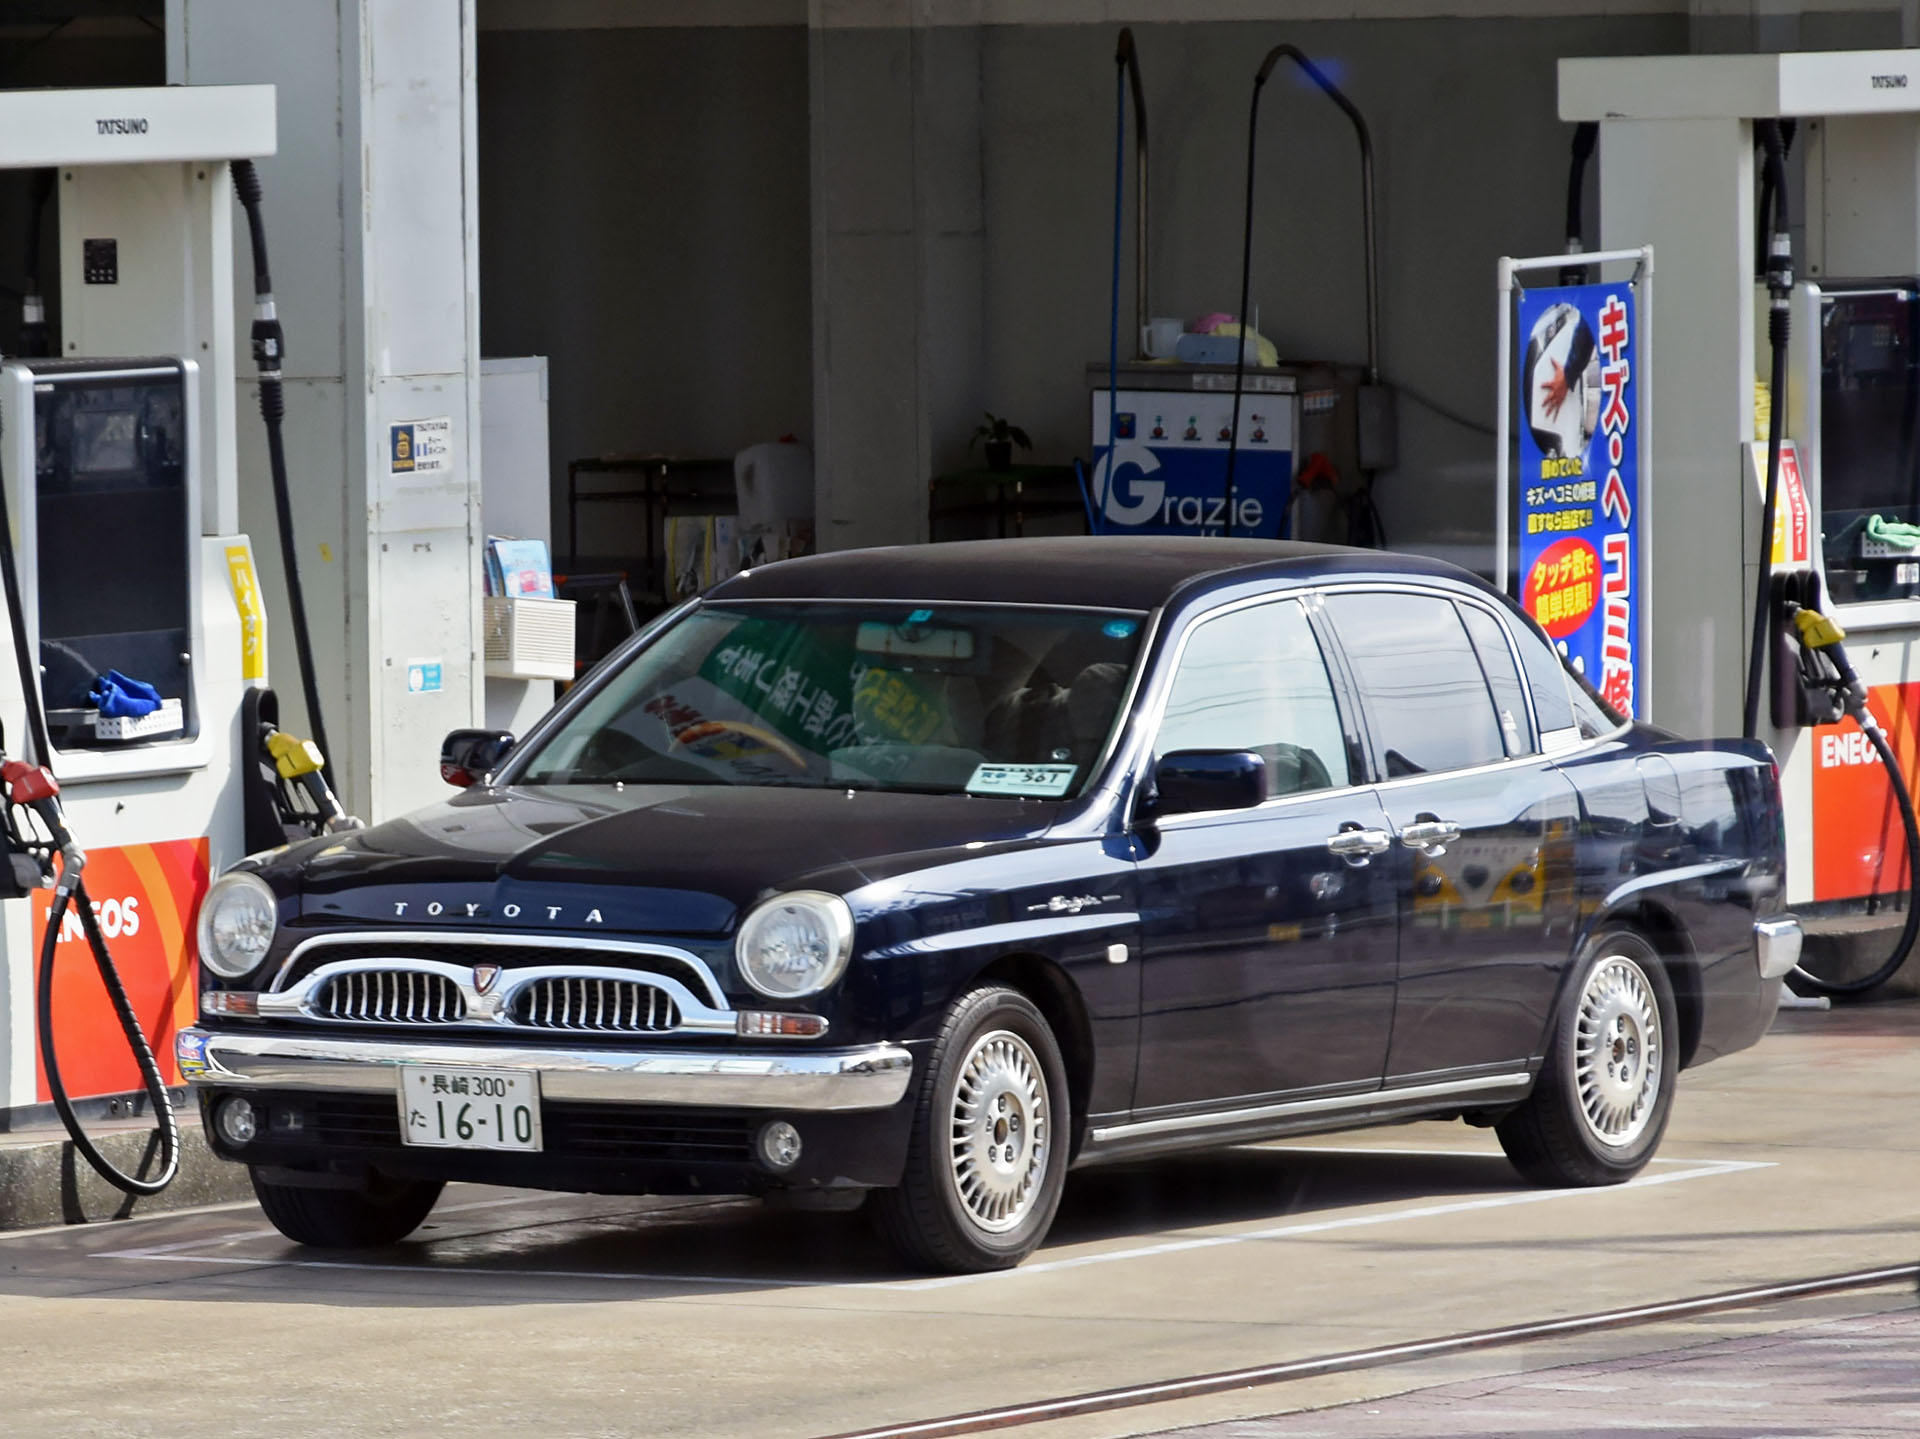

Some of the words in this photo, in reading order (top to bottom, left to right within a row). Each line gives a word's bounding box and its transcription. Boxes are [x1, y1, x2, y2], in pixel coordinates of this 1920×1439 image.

[1871, 75, 1908, 89] TATSUNO
[96, 118, 148, 135] TATSUNO
[1093, 445, 1263, 525] Grazie
[235, 568, 258, 655] ハイオク
[1822, 728, 1888, 769] ENEO
[394, 902, 603, 923] TOYOTA
[410, 1109, 427, 1127] た
[437, 1101, 532, 1143] 16-10
